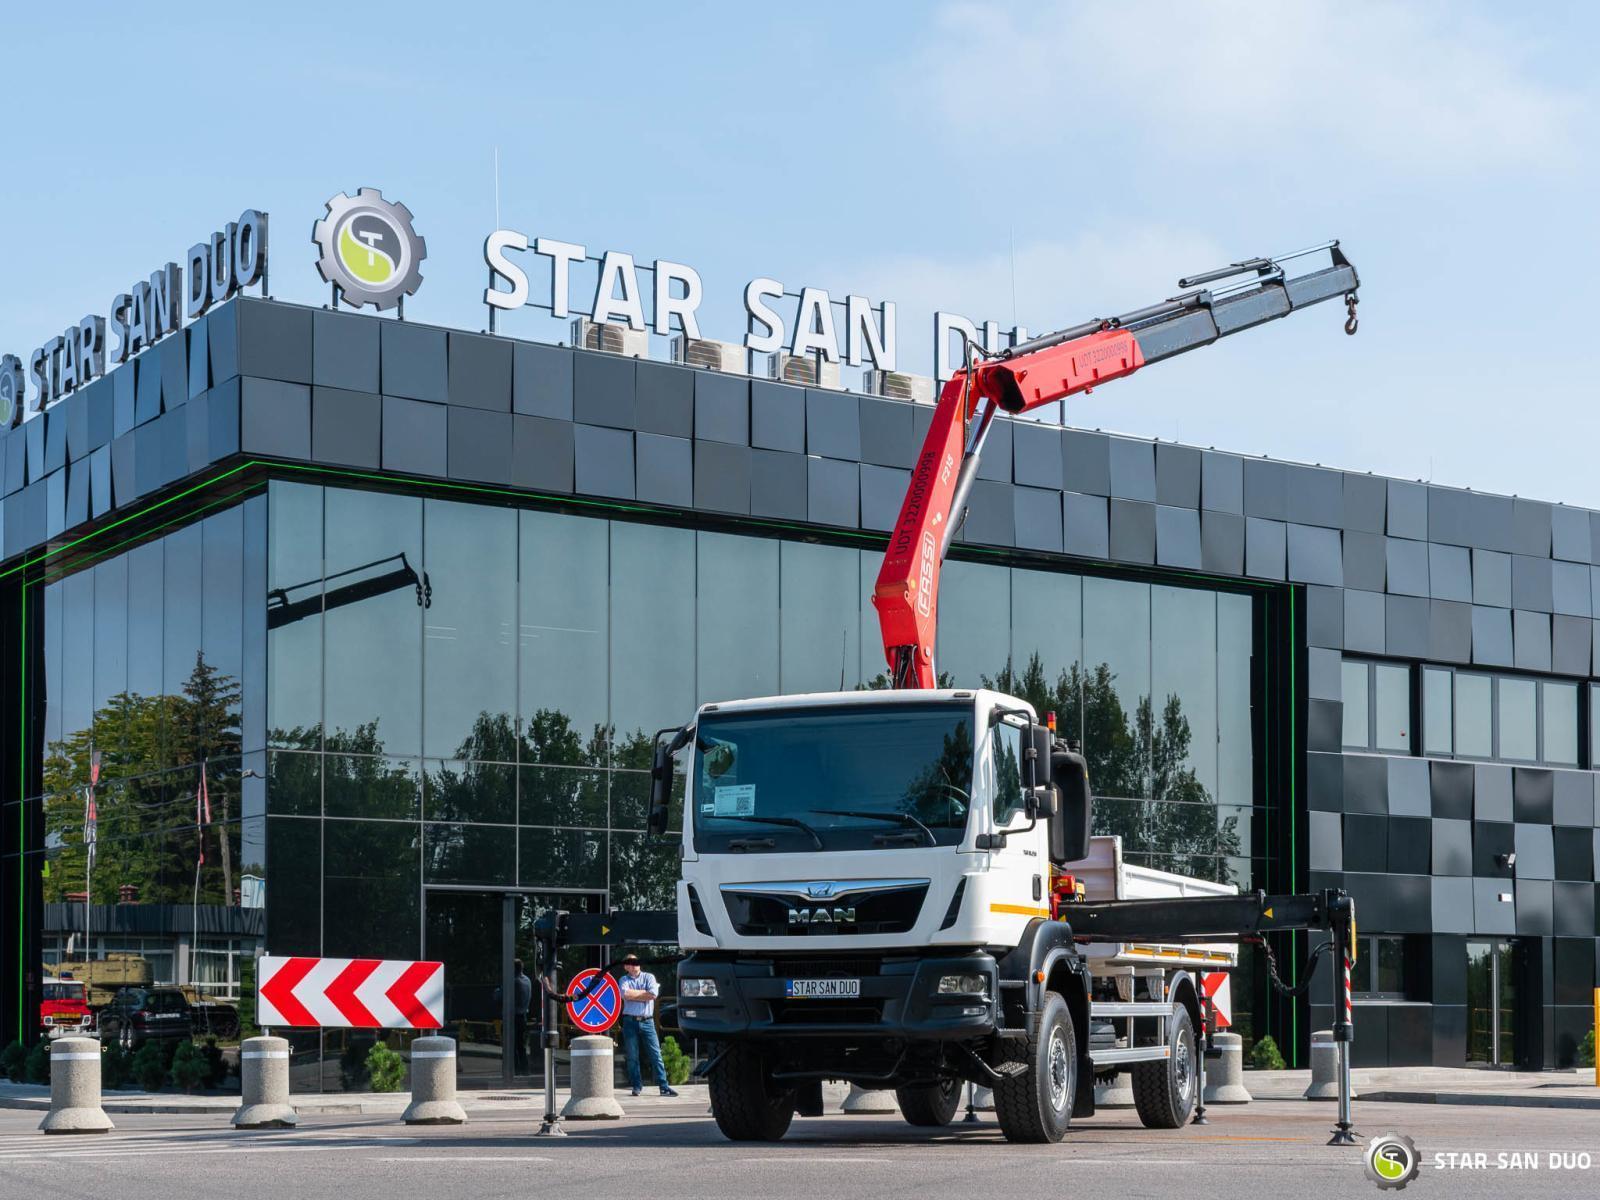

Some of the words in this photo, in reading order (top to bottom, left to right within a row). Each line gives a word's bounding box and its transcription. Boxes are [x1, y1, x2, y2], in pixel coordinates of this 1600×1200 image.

[30, 314, 106, 413] STAR
[111, 262, 182, 363] SAN
[188, 209, 264, 318] DUO
[483, 230, 704, 339] STAR
[744, 278, 897, 372] SAN
[919, 532, 936, 616] FASSI
[788, 907, 856, 923] MAN
[794, 981, 817, 995] STAR
[819, 981, 837, 994] SAN
[840, 980, 858, 994] DUO
